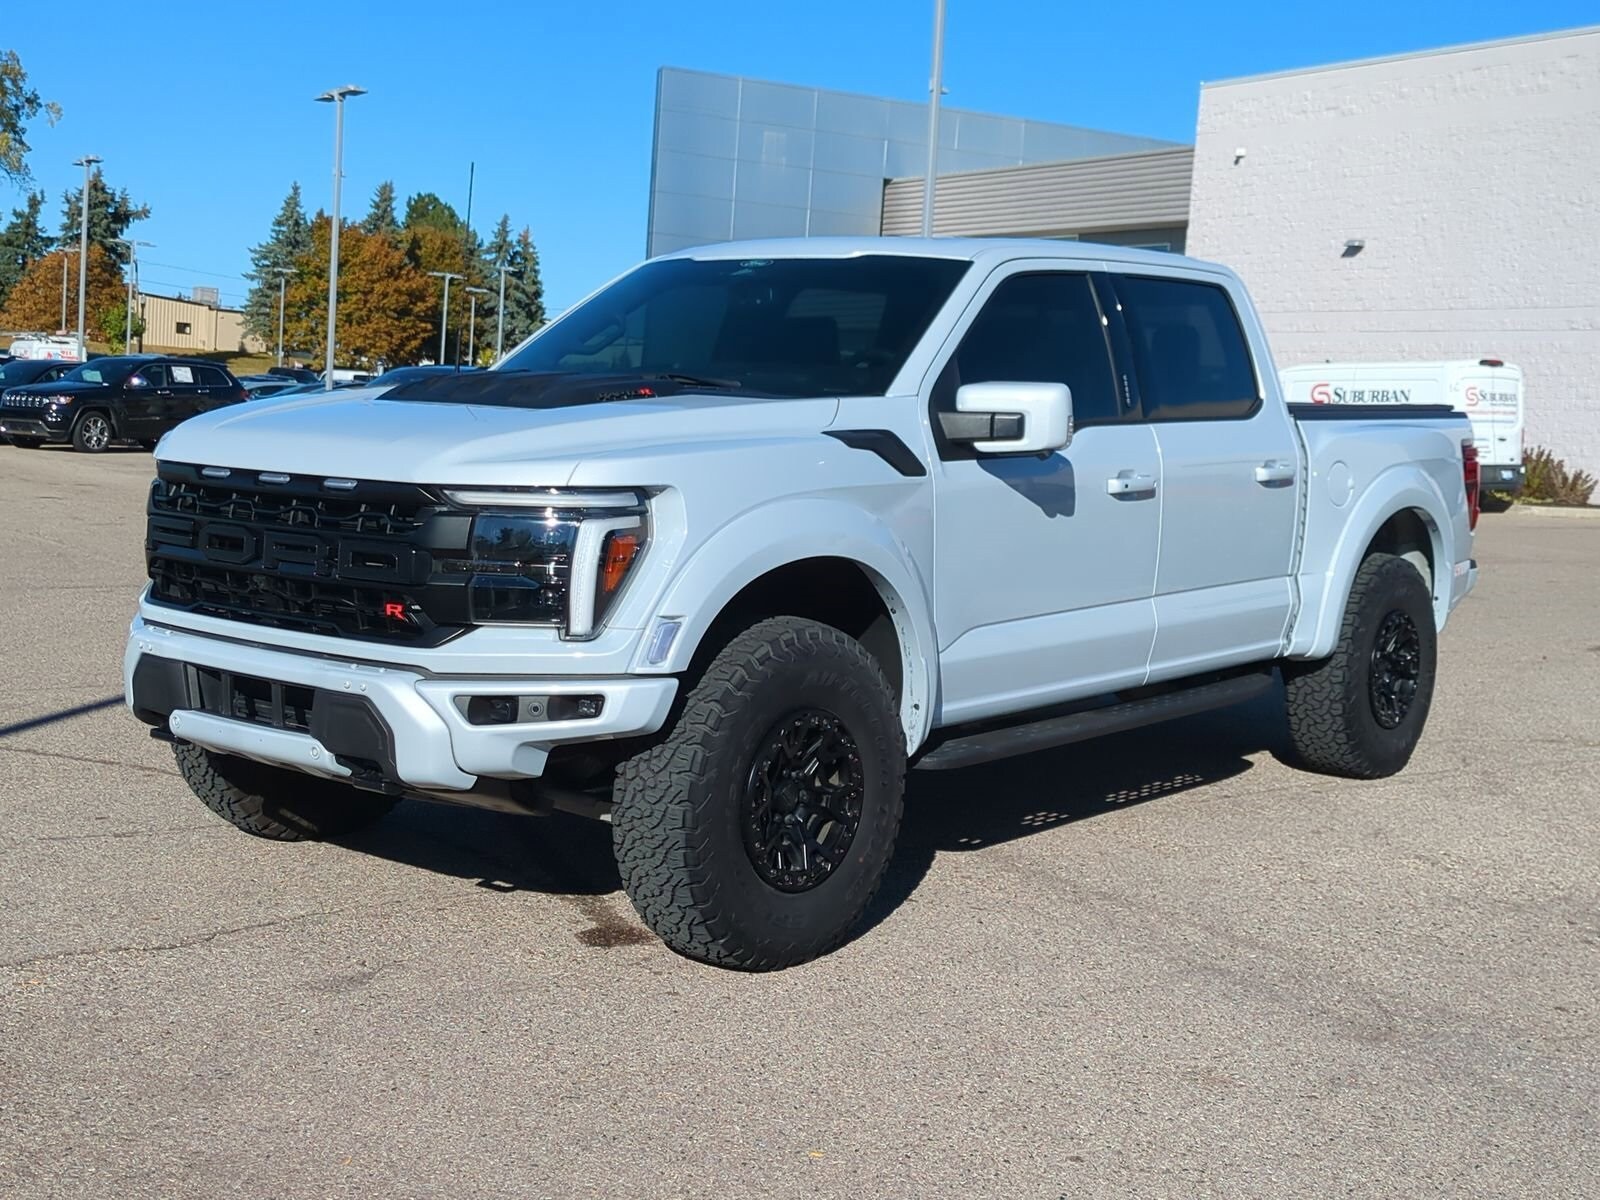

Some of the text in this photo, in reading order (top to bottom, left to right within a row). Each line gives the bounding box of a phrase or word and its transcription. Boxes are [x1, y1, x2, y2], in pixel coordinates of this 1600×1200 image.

[1333, 387, 1410, 403] SUBURBAN
[148, 516, 418, 584] FORD
[385, 602, 405, 621] R
